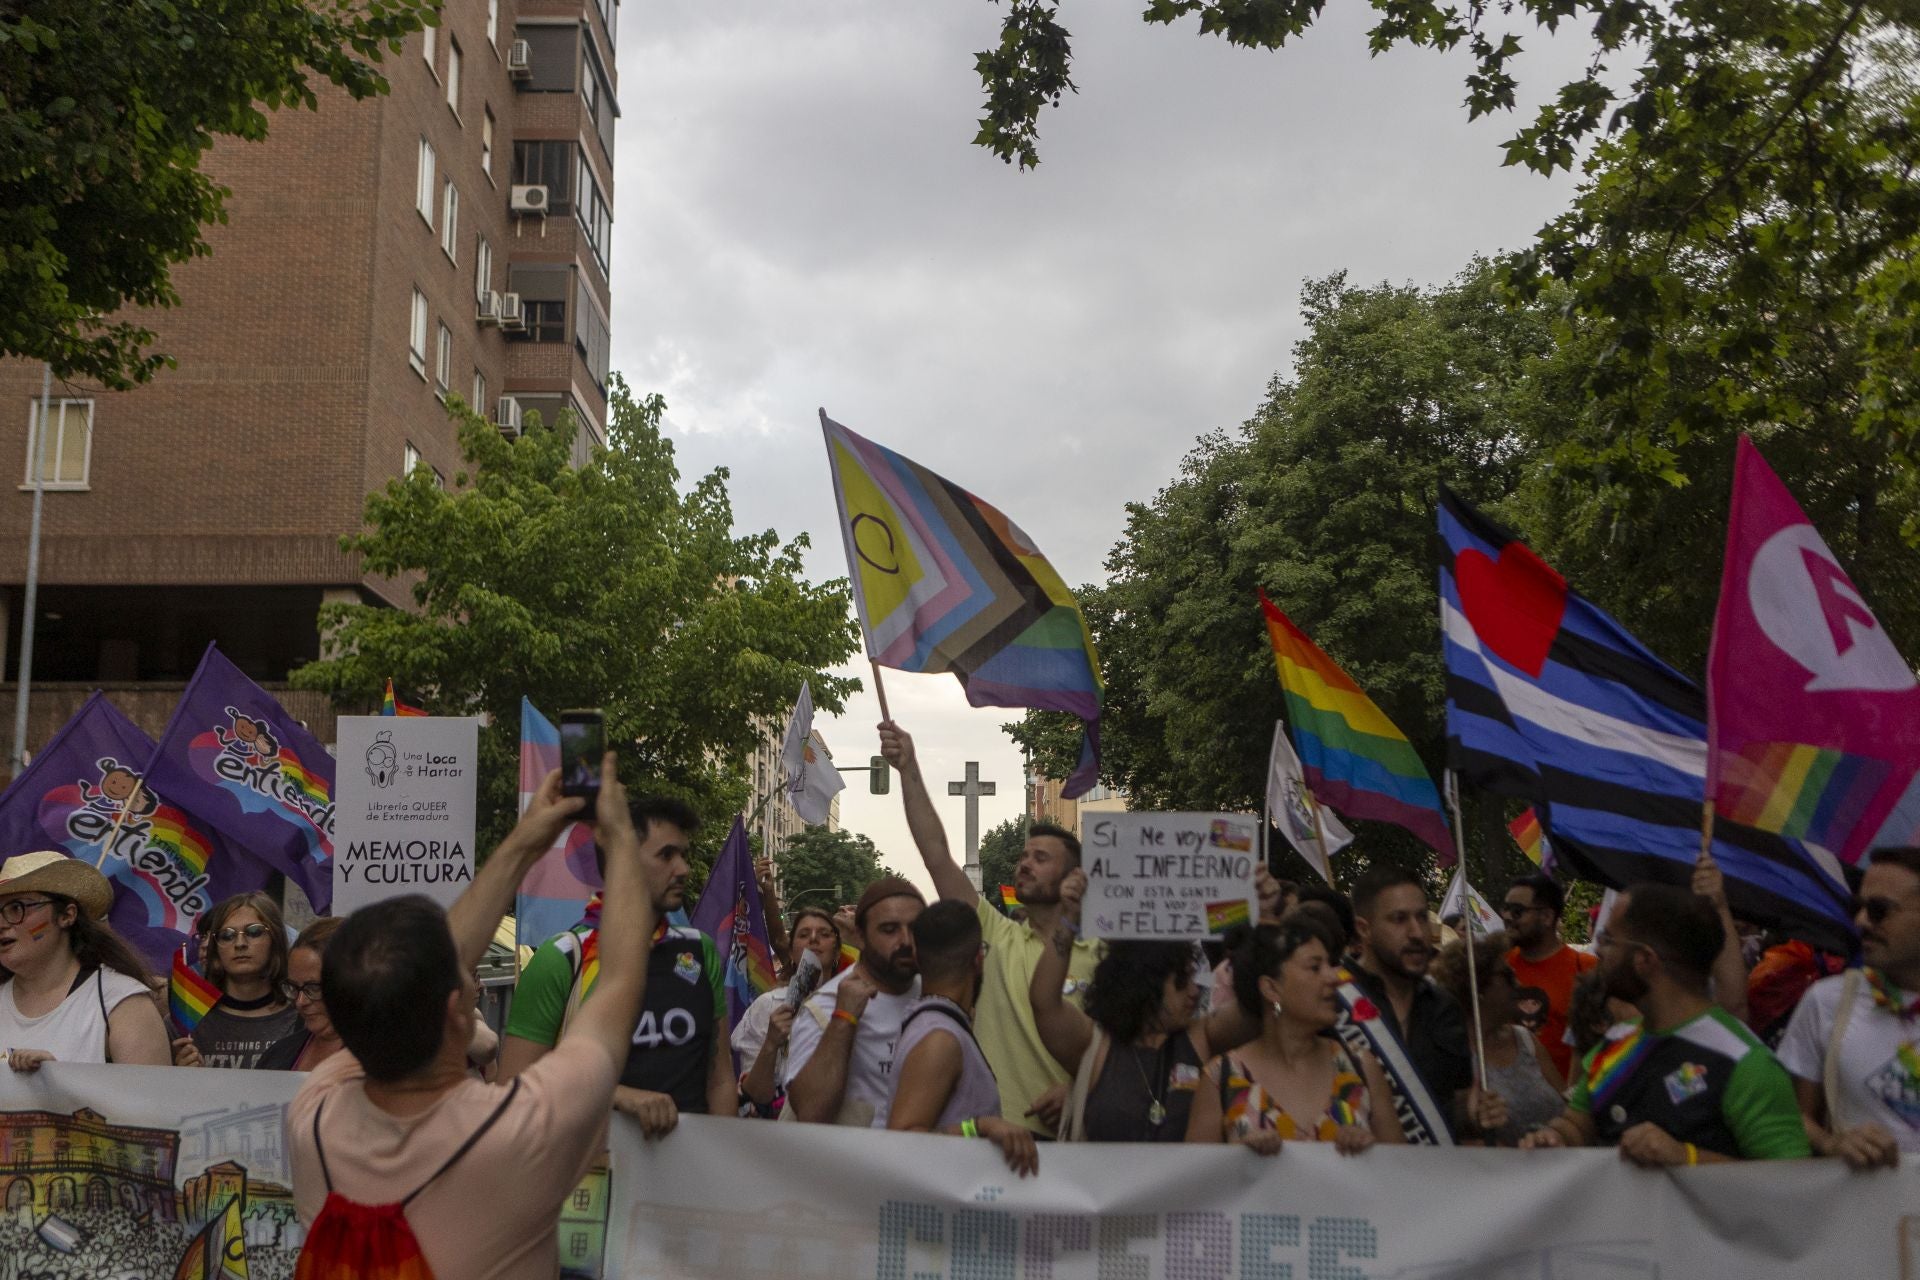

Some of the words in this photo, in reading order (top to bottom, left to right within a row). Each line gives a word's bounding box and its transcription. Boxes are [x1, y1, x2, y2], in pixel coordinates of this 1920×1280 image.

[403, 752, 423, 761] Una
[426, 752, 457, 765] Loca
[418, 766, 463, 778] Hartar
[412, 801, 448, 812] QUEER
[366, 812, 380, 821] de
[383, 812, 449, 821] Extremadura
[1092, 820, 1118, 847] Si
[1175, 831, 1209, 854] voy
[345, 840, 466, 861] MEMORIA
[339, 863, 354, 883] Y
[364, 863, 472, 884] CULTURA
[1089, 857, 1120, 879] AL
[1132, 854, 1251, 881] INFIERNO
[1103, 885, 1136, 899] CON
[1143, 886, 1174, 898] ESTA
[1179, 886, 1220, 898] GENTE
[1119, 911, 1204, 935] FELIZ
[215, 1041, 261, 1051] CLOTHING
